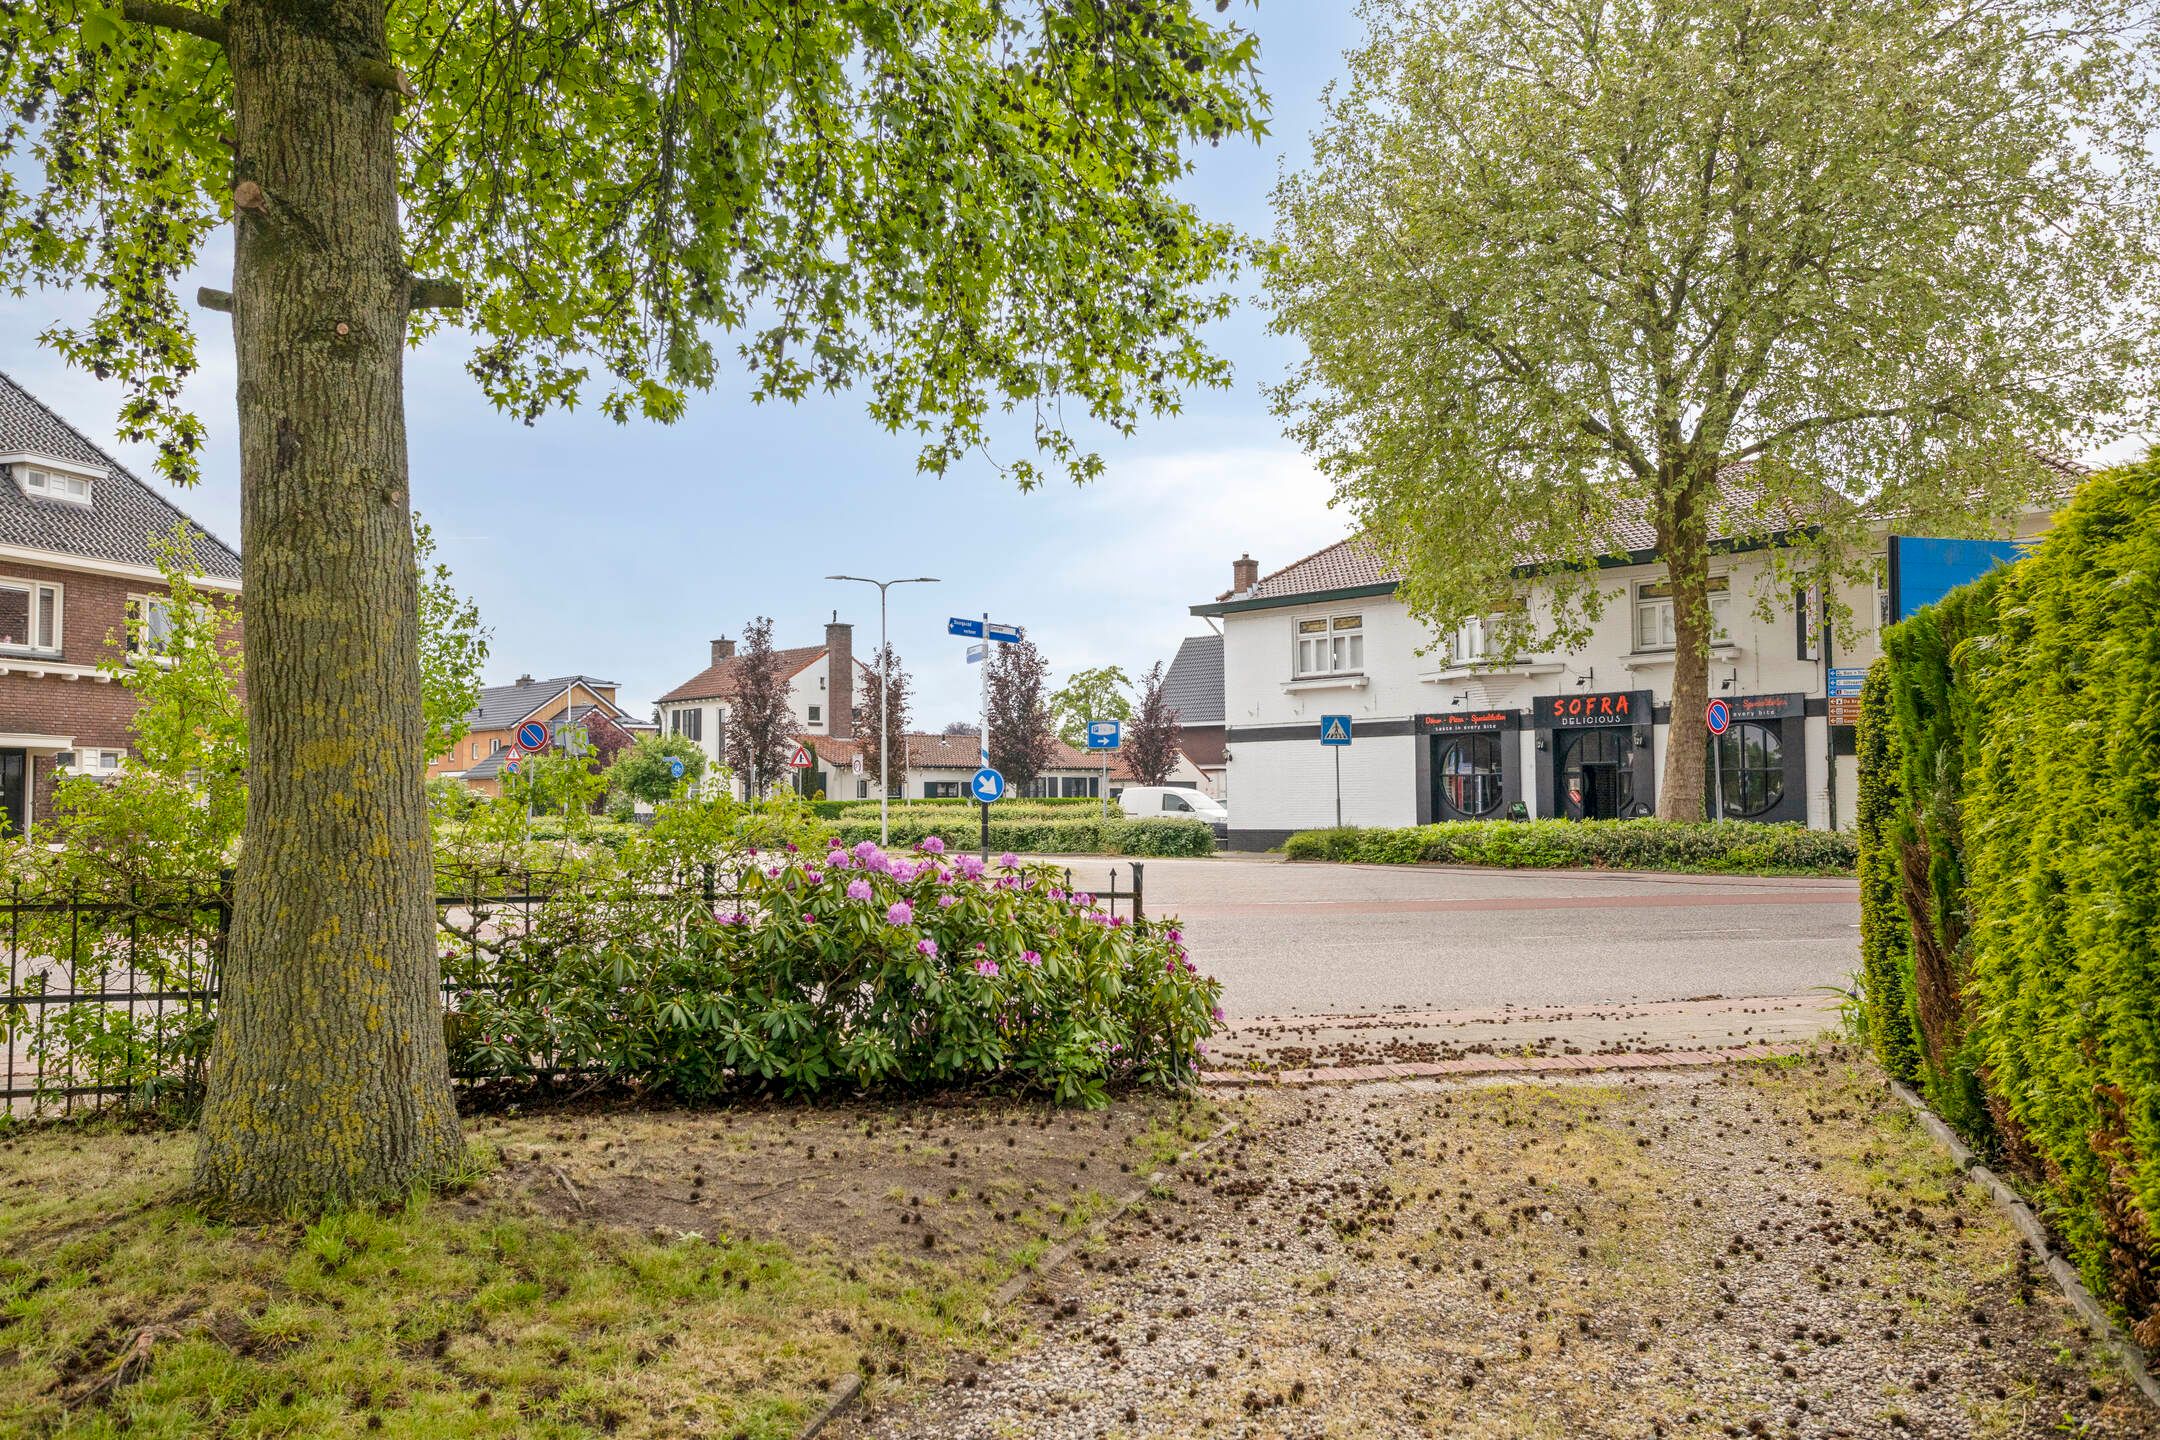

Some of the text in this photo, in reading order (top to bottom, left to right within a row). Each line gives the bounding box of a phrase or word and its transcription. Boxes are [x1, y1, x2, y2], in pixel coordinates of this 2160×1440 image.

[1554, 695, 1628, 716] SOFRA
[1562, 715, 1621, 725] DELICIOUS
[1463, 723, 1481, 731] every
